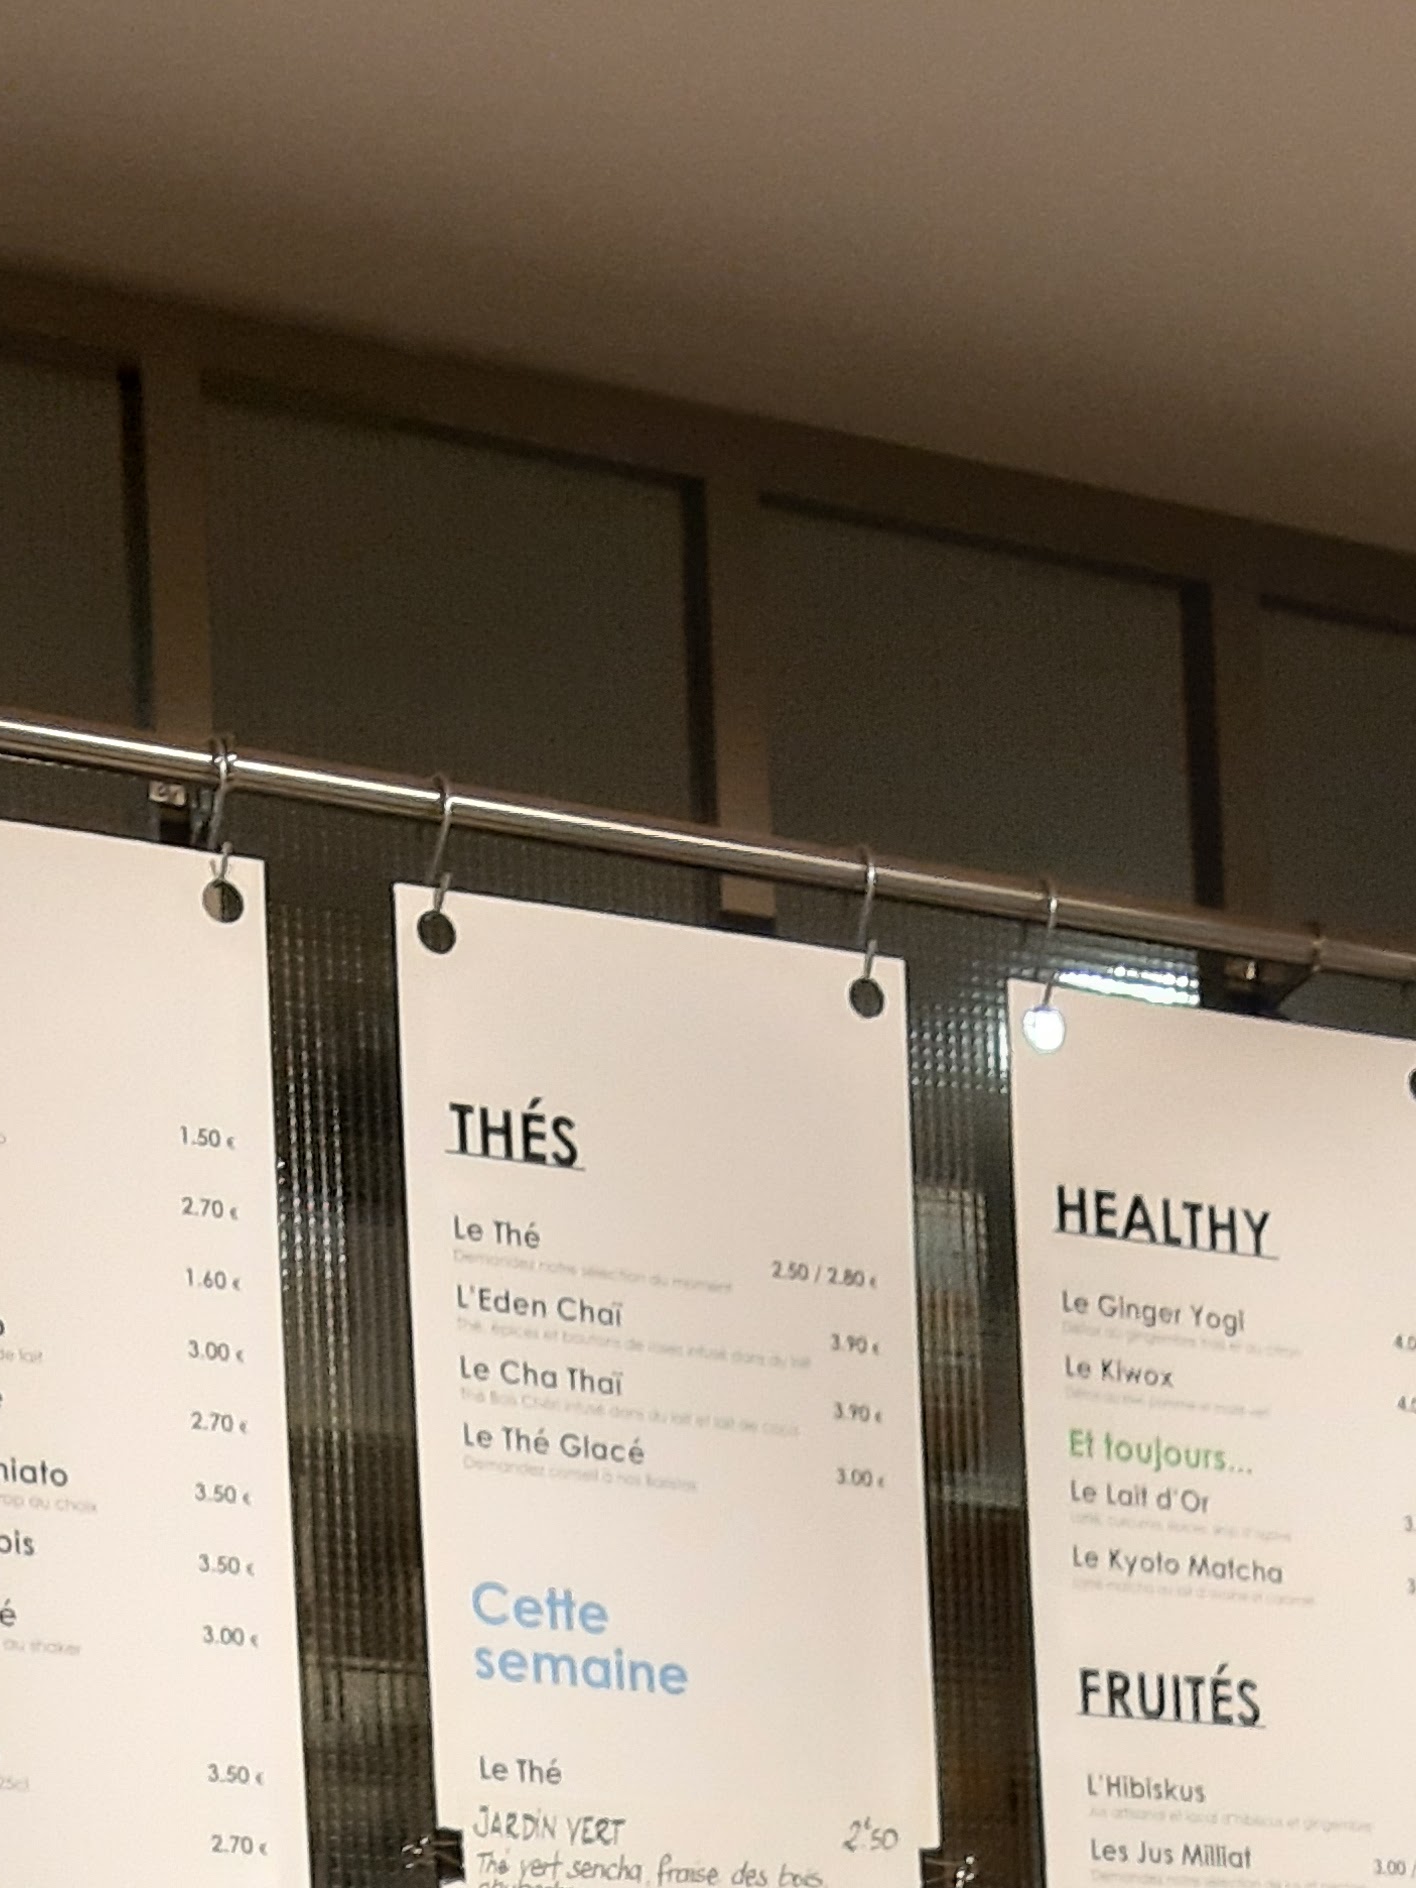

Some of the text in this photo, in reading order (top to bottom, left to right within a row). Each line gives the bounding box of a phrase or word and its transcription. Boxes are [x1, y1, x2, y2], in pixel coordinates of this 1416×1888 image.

[180, 1125, 220, 1147] 1.50
[450, 1097, 577, 1167] THÉS
[182, 1196, 223, 1218] 2.70
[1057, 1184, 1270, 1257] HEALTHY
[454, 1215, 540, 1249] Le Thé
[186, 1267, 226, 1289] 1.60
[457, 1284, 622, 1326] L'Eden Chaï
[1062, 1289, 1244, 1337] Le Ginger Yogi
[188, 1339, 230, 1361] 3.00
[191, 1411, 233, 1432] 2.70
[464, 1422, 644, 1464] Le Thé Glacé
[1069, 1427, 1094, 1458] Et
[195, 1482, 236, 1504] 3.50
[1073, 1544, 1282, 1584] Le Kyoto Matcha
[472, 1581, 608, 1634] Cette
[474, 1646, 688, 1695] semaine
[1079, 1663, 1261, 1726] FRUITÉS
